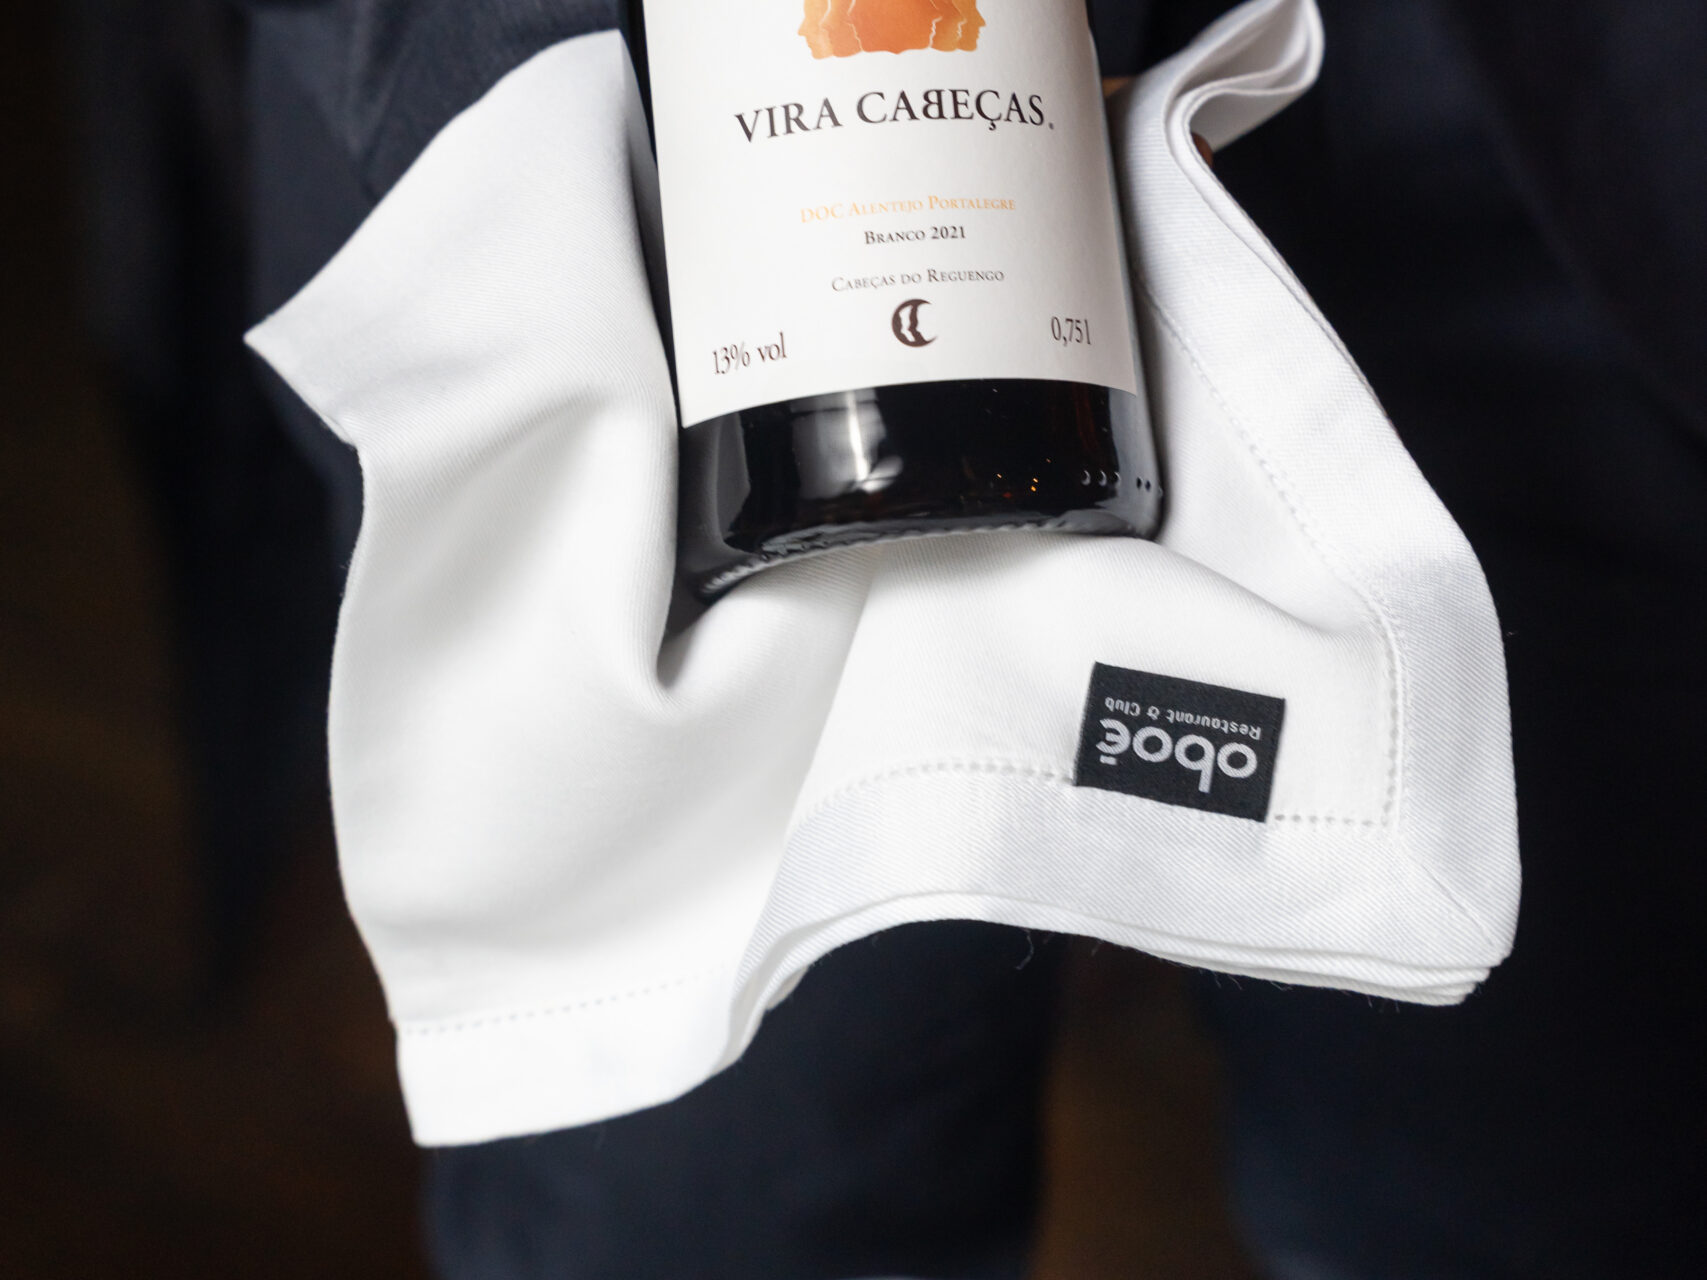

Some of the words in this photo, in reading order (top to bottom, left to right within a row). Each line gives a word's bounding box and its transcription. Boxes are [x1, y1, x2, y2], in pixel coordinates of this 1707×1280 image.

[734, 97, 843, 143] VIRA
[800, 202, 844, 224] DOC
[931, 225, 966, 240] 2021
[711, 341, 751, 376] 13%
[757, 331, 789, 363] vol
[1104, 696, 1141, 717] Club
[1146, 705, 1160, 721] &
[1165, 709, 1262, 741] Restaurant
